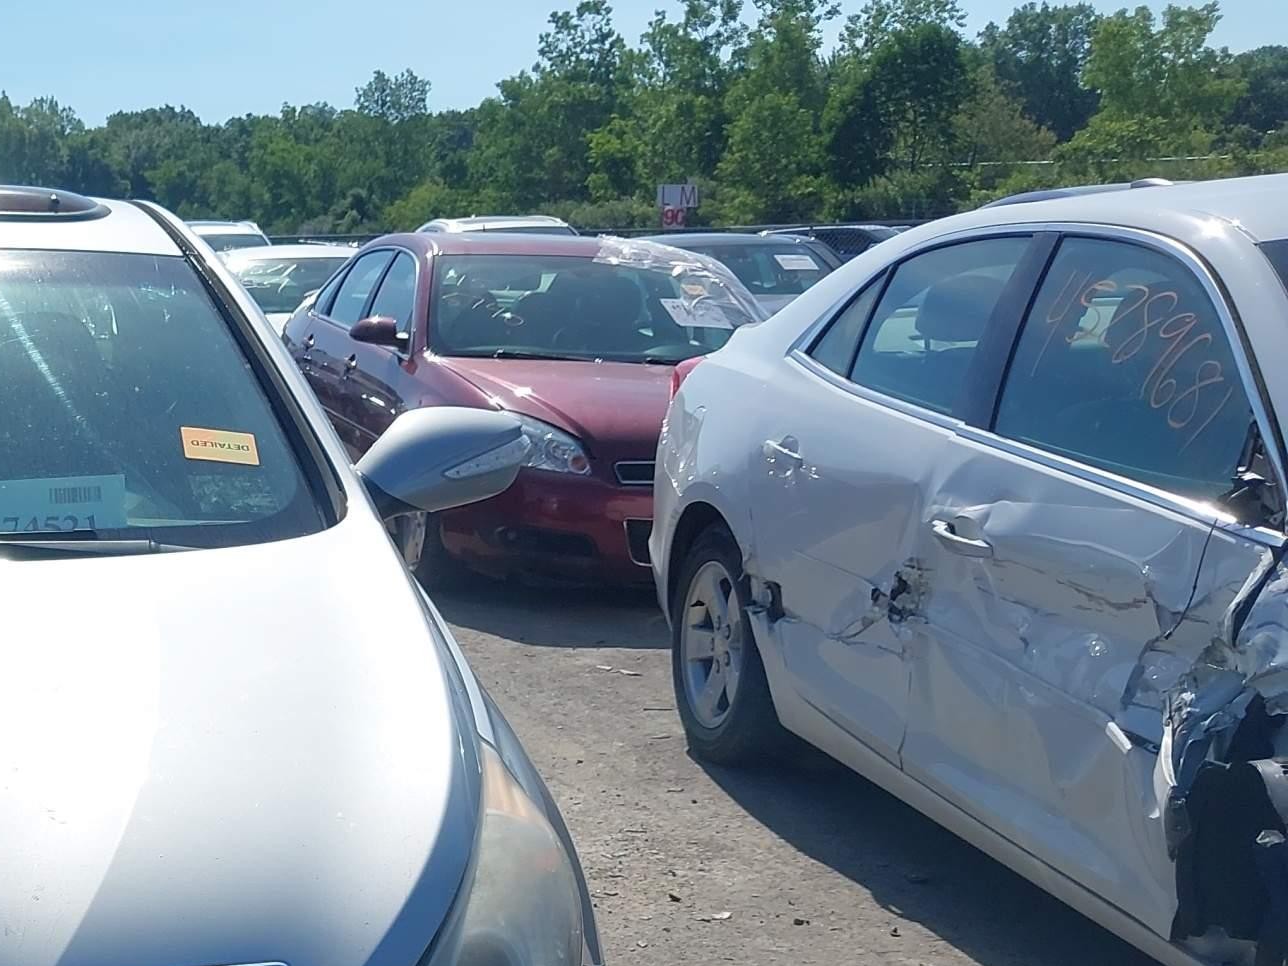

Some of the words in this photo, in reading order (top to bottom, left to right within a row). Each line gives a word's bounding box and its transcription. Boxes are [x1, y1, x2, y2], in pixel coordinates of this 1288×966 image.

[662, 185, 671, 206] L
[679, 186, 697, 206] M
[190, 439, 250, 452] DETAILED
